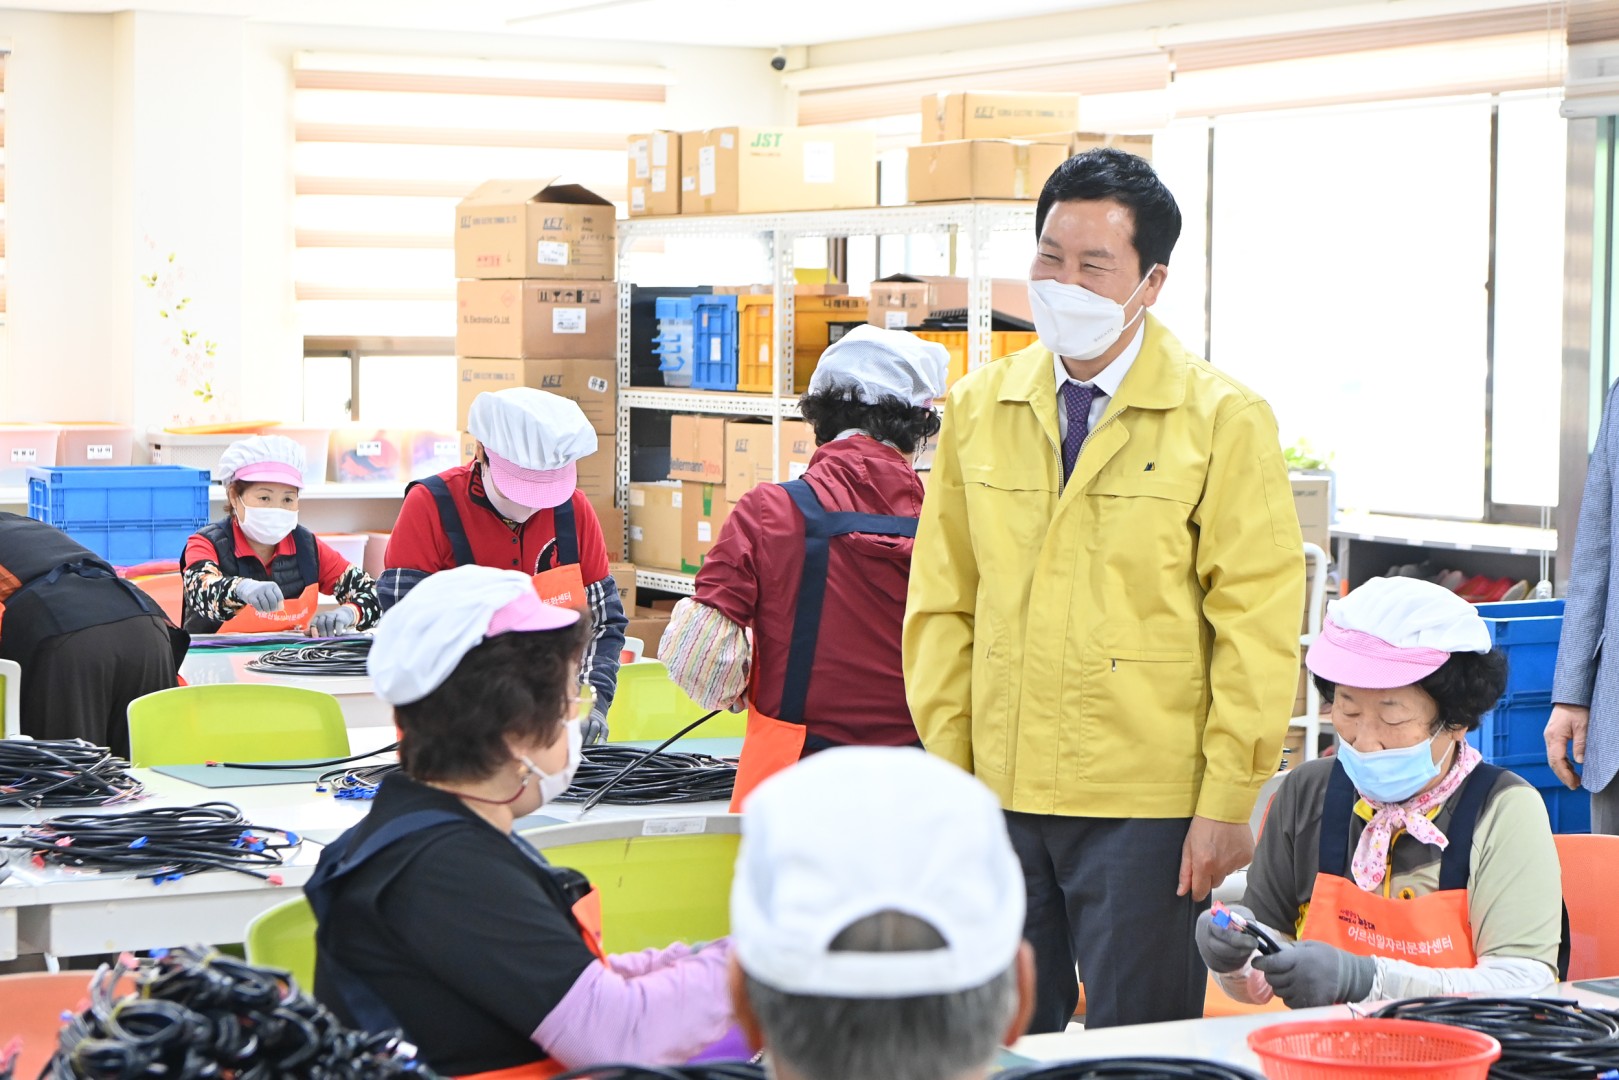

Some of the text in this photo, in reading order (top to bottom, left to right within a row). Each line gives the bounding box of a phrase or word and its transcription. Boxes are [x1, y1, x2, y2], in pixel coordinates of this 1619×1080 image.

[750, 133, 783, 148] JST
[543, 217, 564, 230] KET
[541, 375, 564, 388] KET
[735, 438, 749, 453] KET
[1348, 925, 1453, 955] 어르신일자리문화센터
